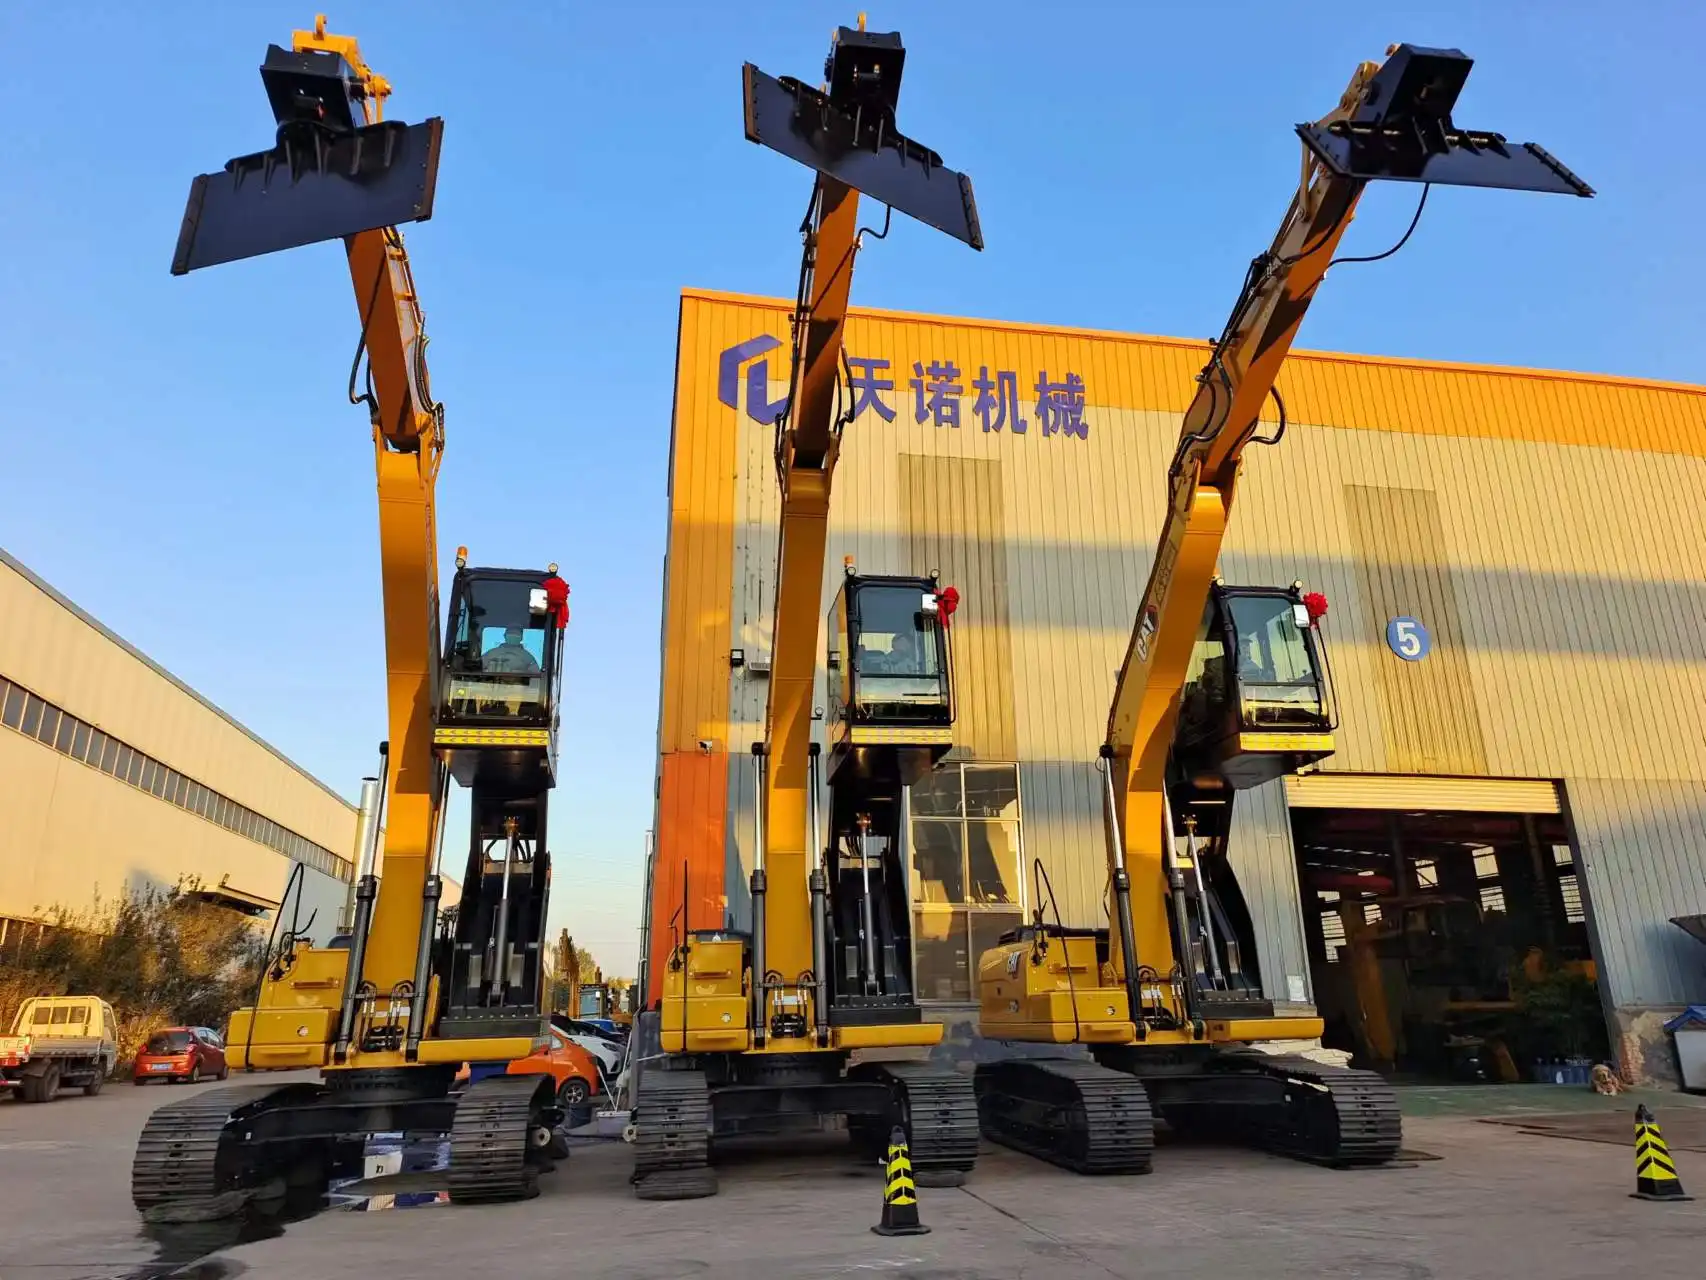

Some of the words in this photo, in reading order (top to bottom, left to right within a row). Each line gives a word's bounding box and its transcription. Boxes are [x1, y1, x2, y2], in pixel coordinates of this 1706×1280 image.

[845, 357, 1088, 440] 天诺机械
[1137, 613, 1155, 661] CAT
[1396, 622, 1420, 656] 5
